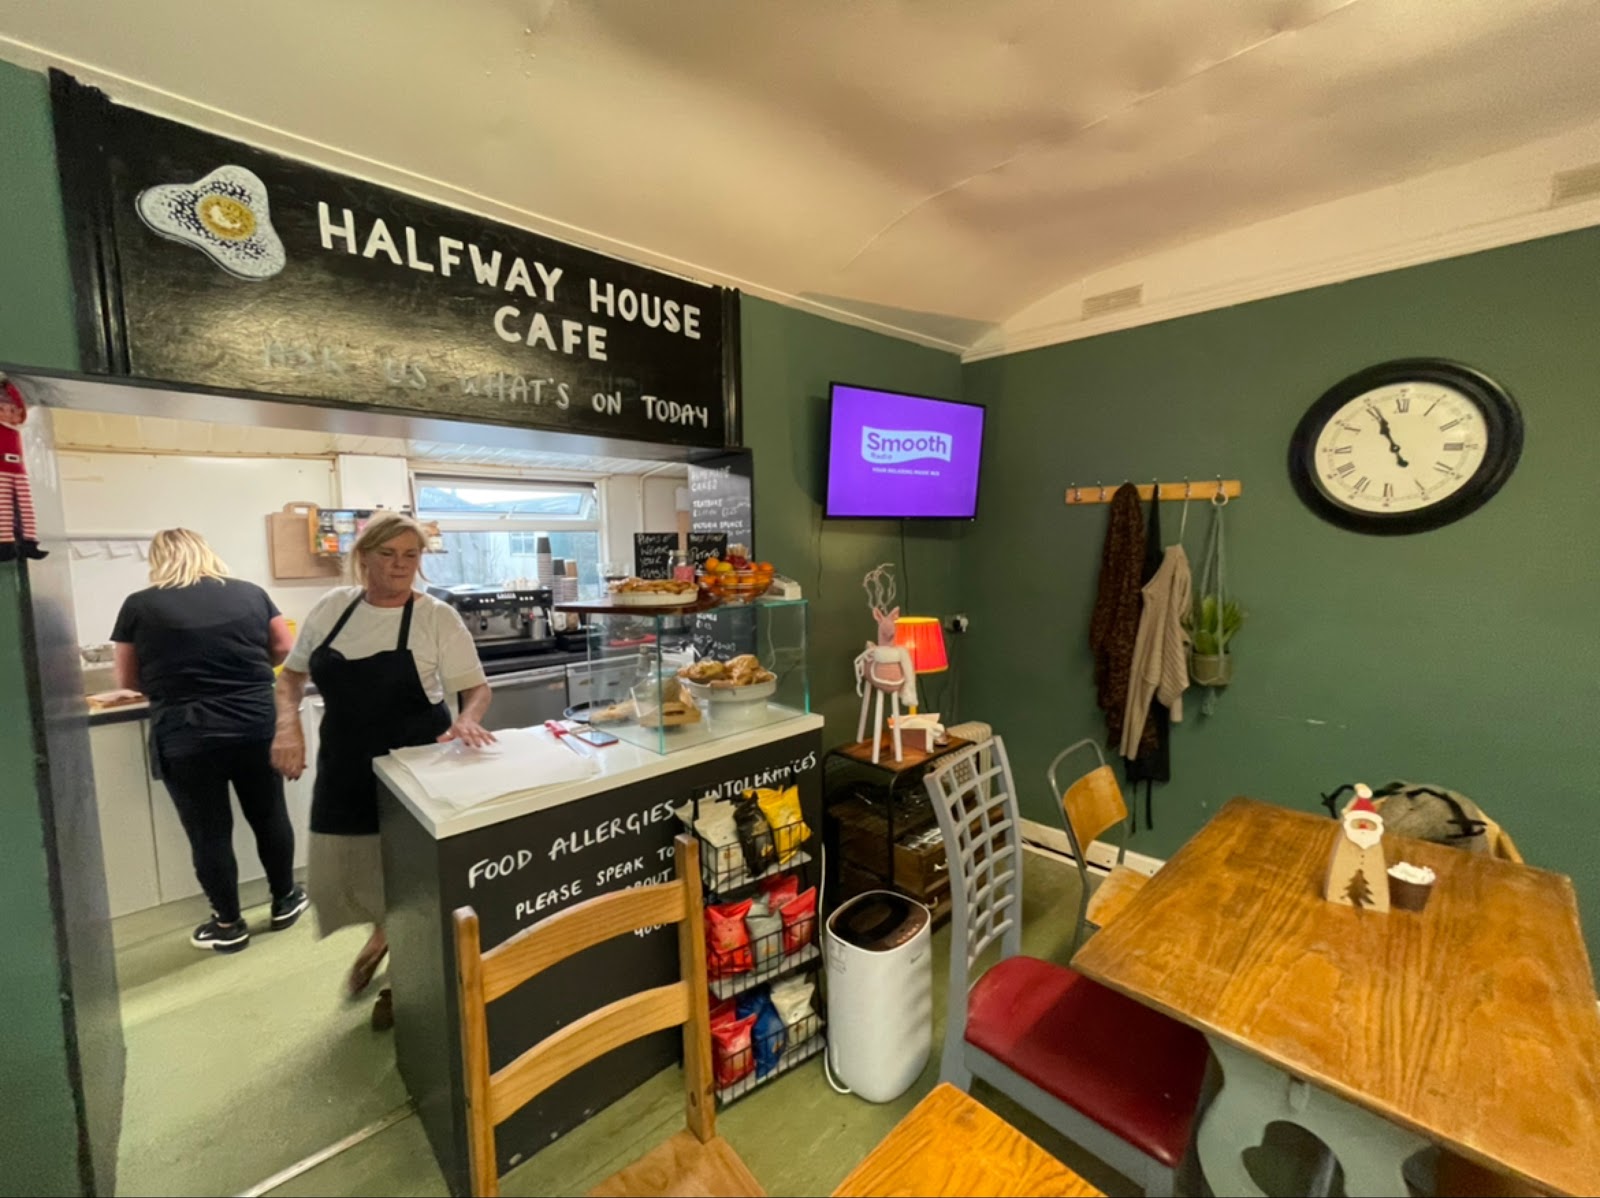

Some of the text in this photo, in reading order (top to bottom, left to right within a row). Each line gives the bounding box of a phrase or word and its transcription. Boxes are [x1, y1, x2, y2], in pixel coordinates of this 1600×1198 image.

[317, 201, 701, 340] HALFWAY HOUSE
[494, 306, 608, 362] CAFE
[386, 359, 427, 391] US
[592, 391, 622, 415] ON
[640, 395, 708, 429] TODAY
[866, 432, 947, 454] Smooth
[468, 849, 533, 889] FOOD
[548, 799, 676, 861] ALLERGIES
[515, 846, 676, 920] PLEASE SPEAK TO
